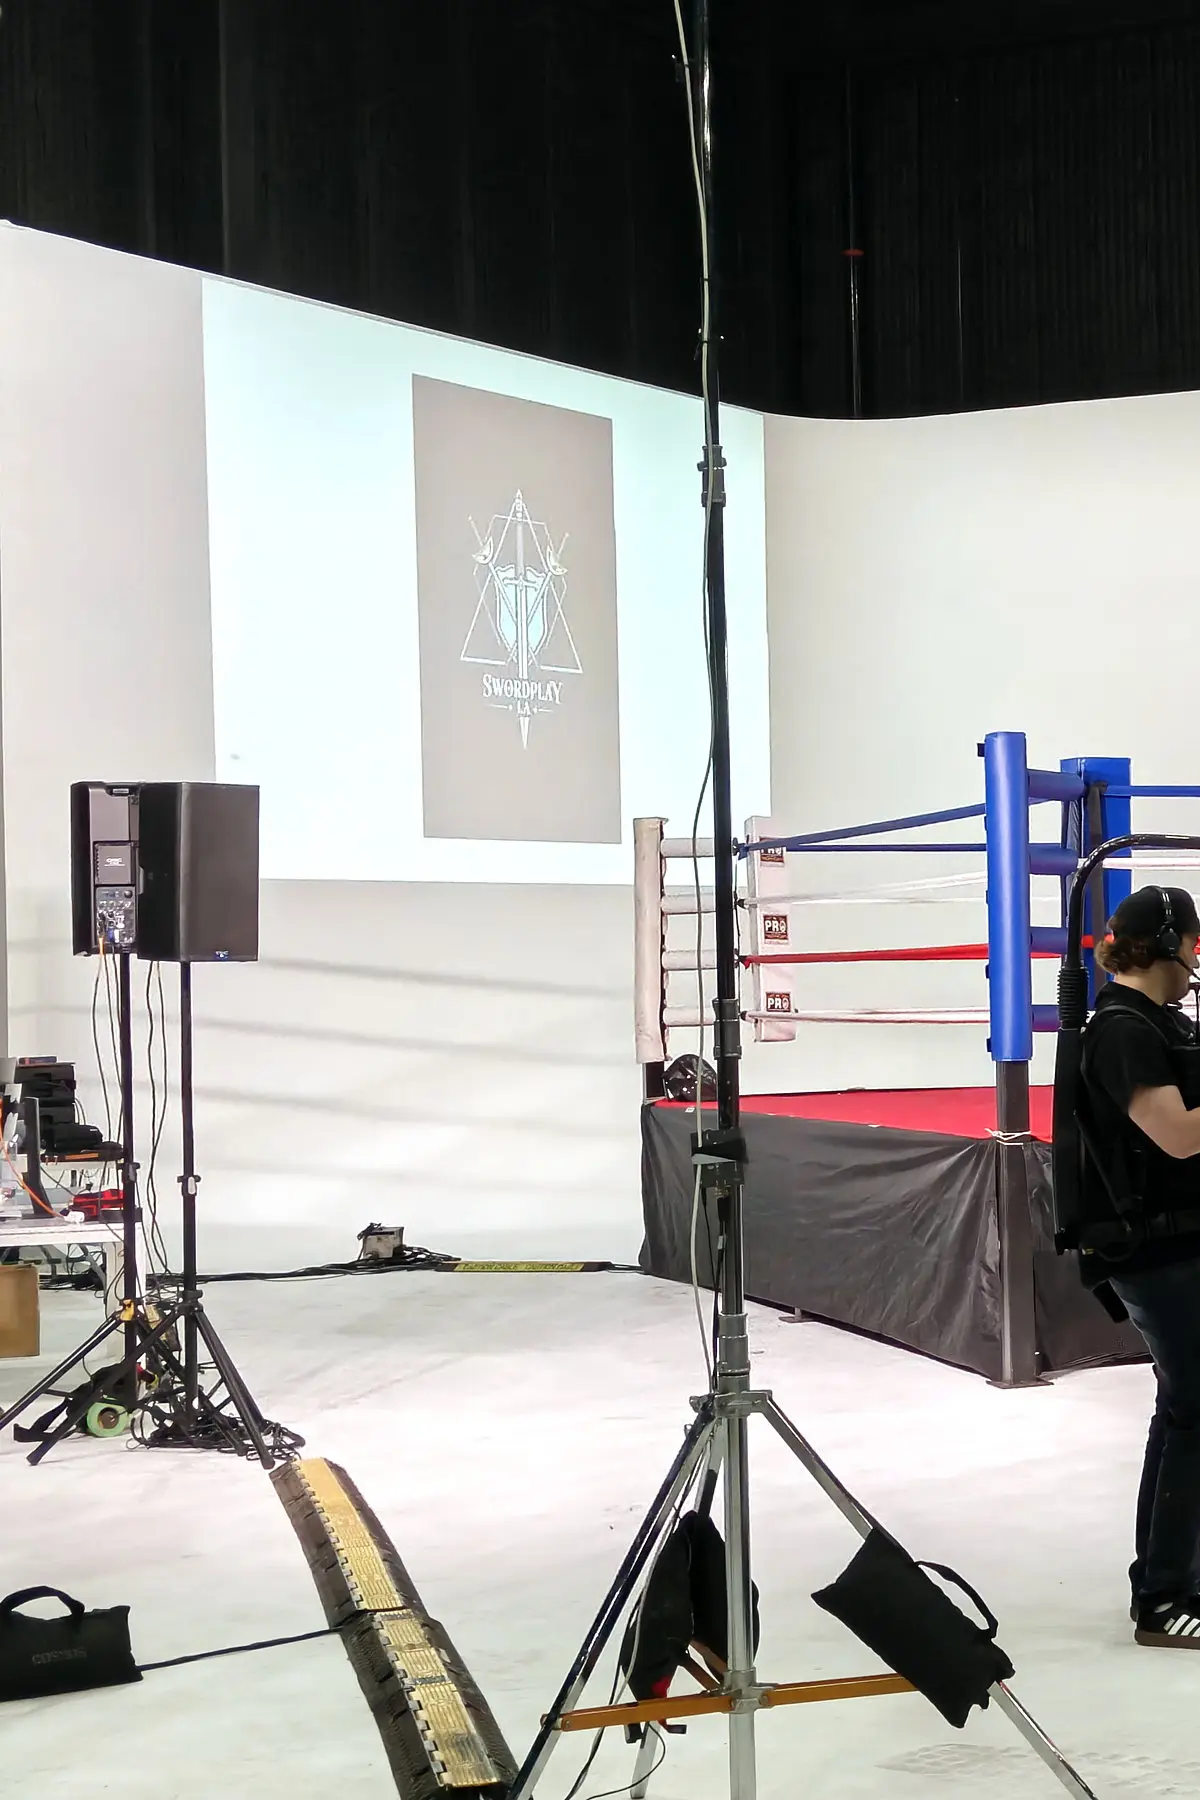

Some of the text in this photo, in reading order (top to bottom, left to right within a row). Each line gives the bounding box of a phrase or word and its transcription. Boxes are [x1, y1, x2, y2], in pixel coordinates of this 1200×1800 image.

[482, 673, 563, 704] SWORDPLAY
[765, 920, 786, 932] PRO
[767, 999, 789, 1010] PRO
